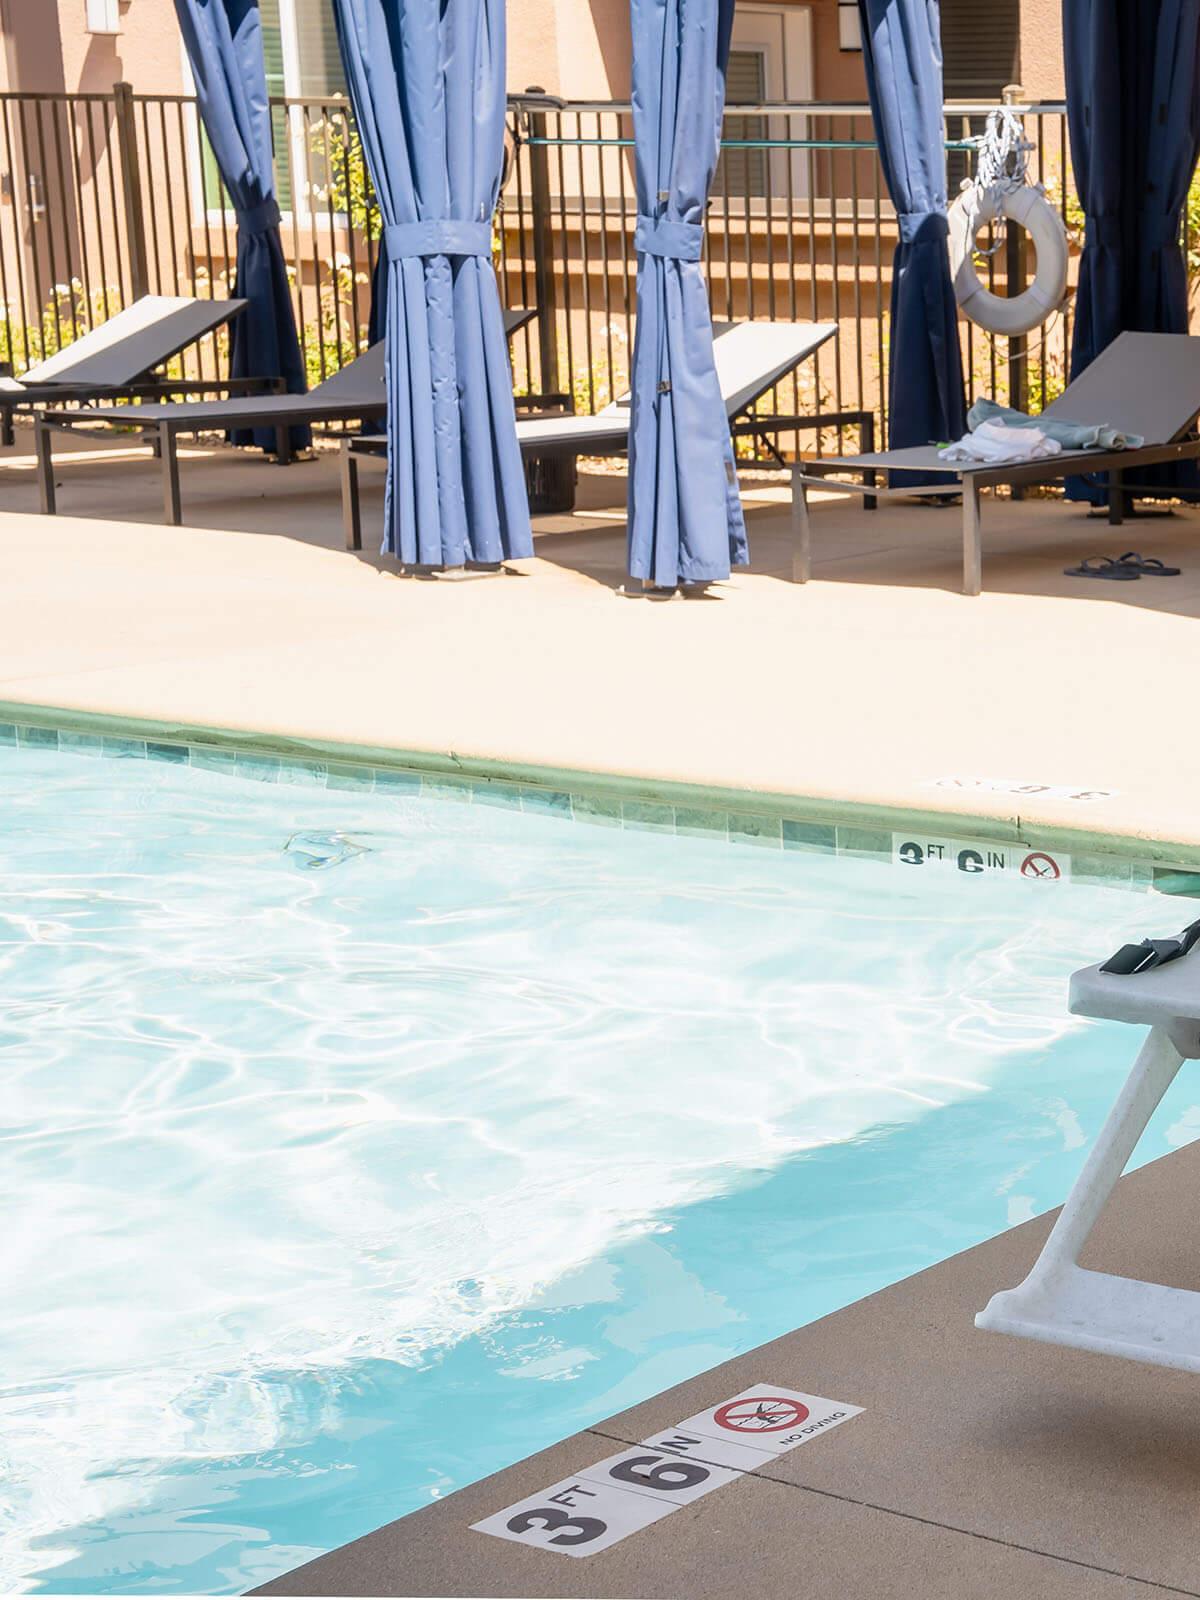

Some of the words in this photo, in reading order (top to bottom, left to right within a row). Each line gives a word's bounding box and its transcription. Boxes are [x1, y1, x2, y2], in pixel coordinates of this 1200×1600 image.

[927, 844, 945, 860] FT
[988, 851, 1004, 869] IN
[779, 1434, 802, 1445] NO
[801, 1411, 847, 1434] DIVING
[653, 1435, 702, 1456] IN
[609, 1456, 710, 1490] 6
[547, 1484, 597, 1507] FT
[506, 1508, 607, 1546] 3
